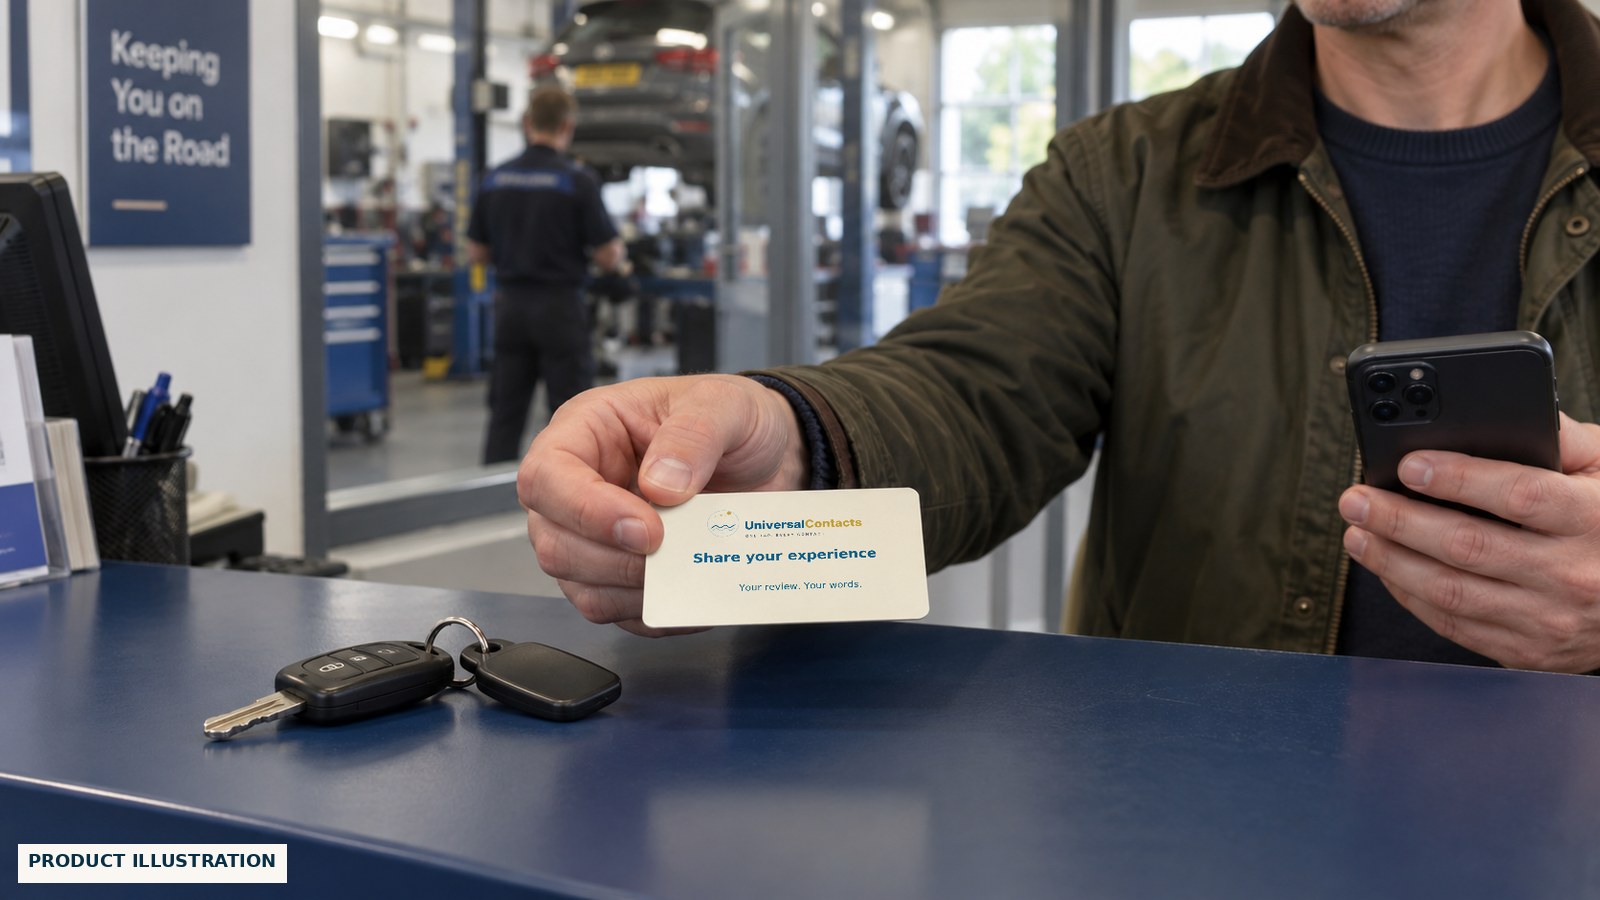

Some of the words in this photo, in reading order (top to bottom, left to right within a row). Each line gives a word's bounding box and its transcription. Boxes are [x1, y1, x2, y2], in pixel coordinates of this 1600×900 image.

[110, 29, 220, 86] Keeping
[111, 78, 164, 117] You
[168, 92, 203, 120] on
[110, 125, 159, 163] the
[164, 130, 230, 166] Road
[744, 518, 863, 531] UniversalContacts
[693, 552, 741, 564] Share
[745, 552, 784, 565] your
[787, 549, 877, 563] experience
[738, 583, 763, 592] Your
[764, 581, 801, 591] review.
[803, 581, 828, 590] Your
[829, 579, 863, 589] words.
